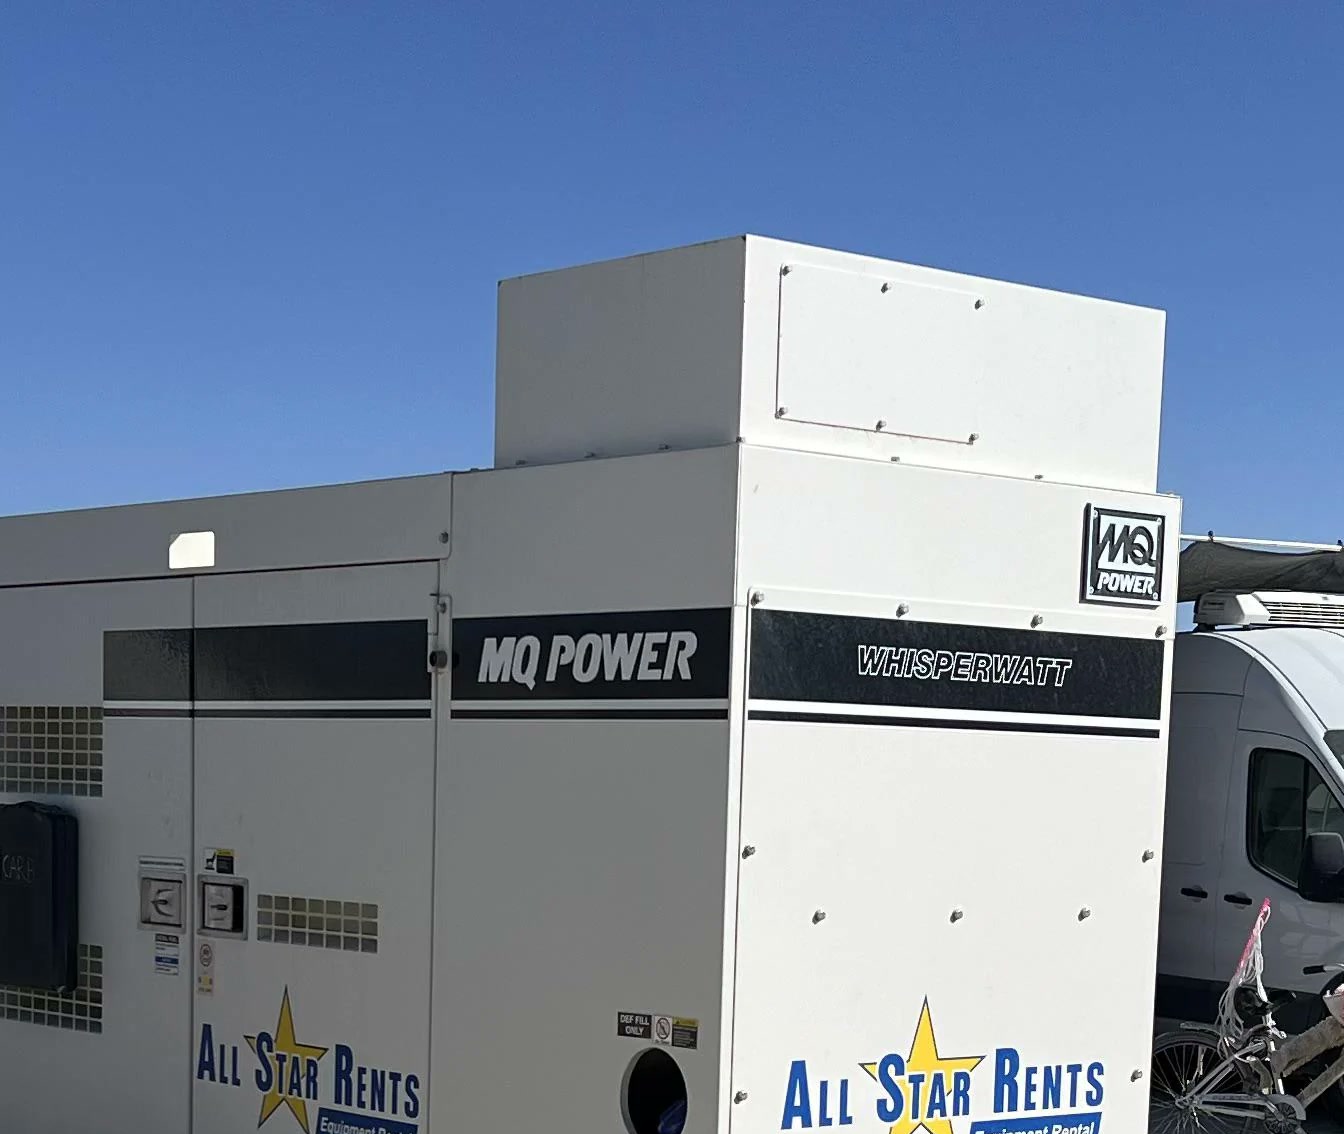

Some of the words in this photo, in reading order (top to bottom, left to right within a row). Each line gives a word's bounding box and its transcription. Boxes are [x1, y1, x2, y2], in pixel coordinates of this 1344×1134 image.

[1097, 522, 1156, 567] MQ
[1097, 571, 1156, 595] POWER
[476, 635, 537, 692] MQ
[545, 630, 700, 684] POWER
[856, 643, 1074, 688] WHISPERWATT
[624, 1025, 644, 1036] ONLY
[635, 1015, 650, 1025] FILL
